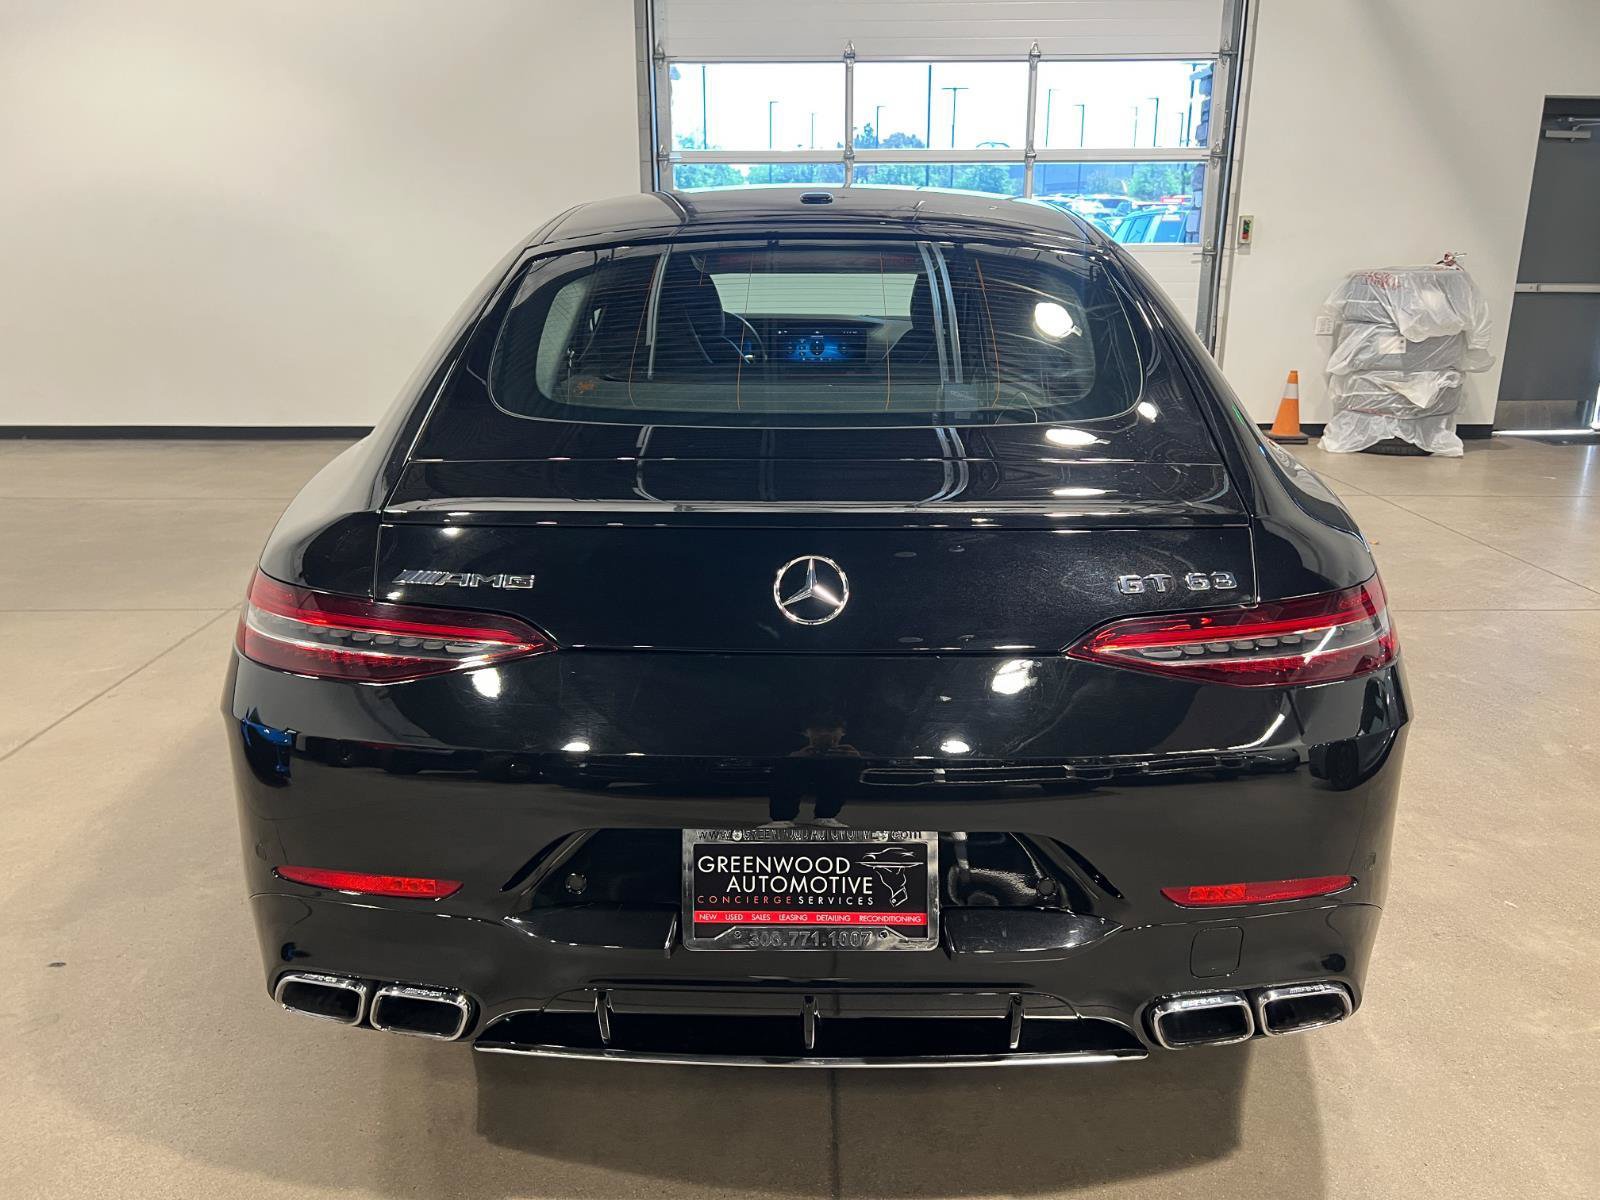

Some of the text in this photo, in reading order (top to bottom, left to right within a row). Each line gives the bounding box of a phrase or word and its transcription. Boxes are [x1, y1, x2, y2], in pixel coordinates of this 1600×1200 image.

[1117, 571, 1238, 594] GT 63
[697, 855, 851, 874] GREENWOOD
[726, 875, 873, 895] AUTOMOTIVE
[697, 895, 874, 905] CONCIERGE SERVICES
[699, 913, 922, 923] NEW USED SALES LEASING DETAILING RECONDITIONING
